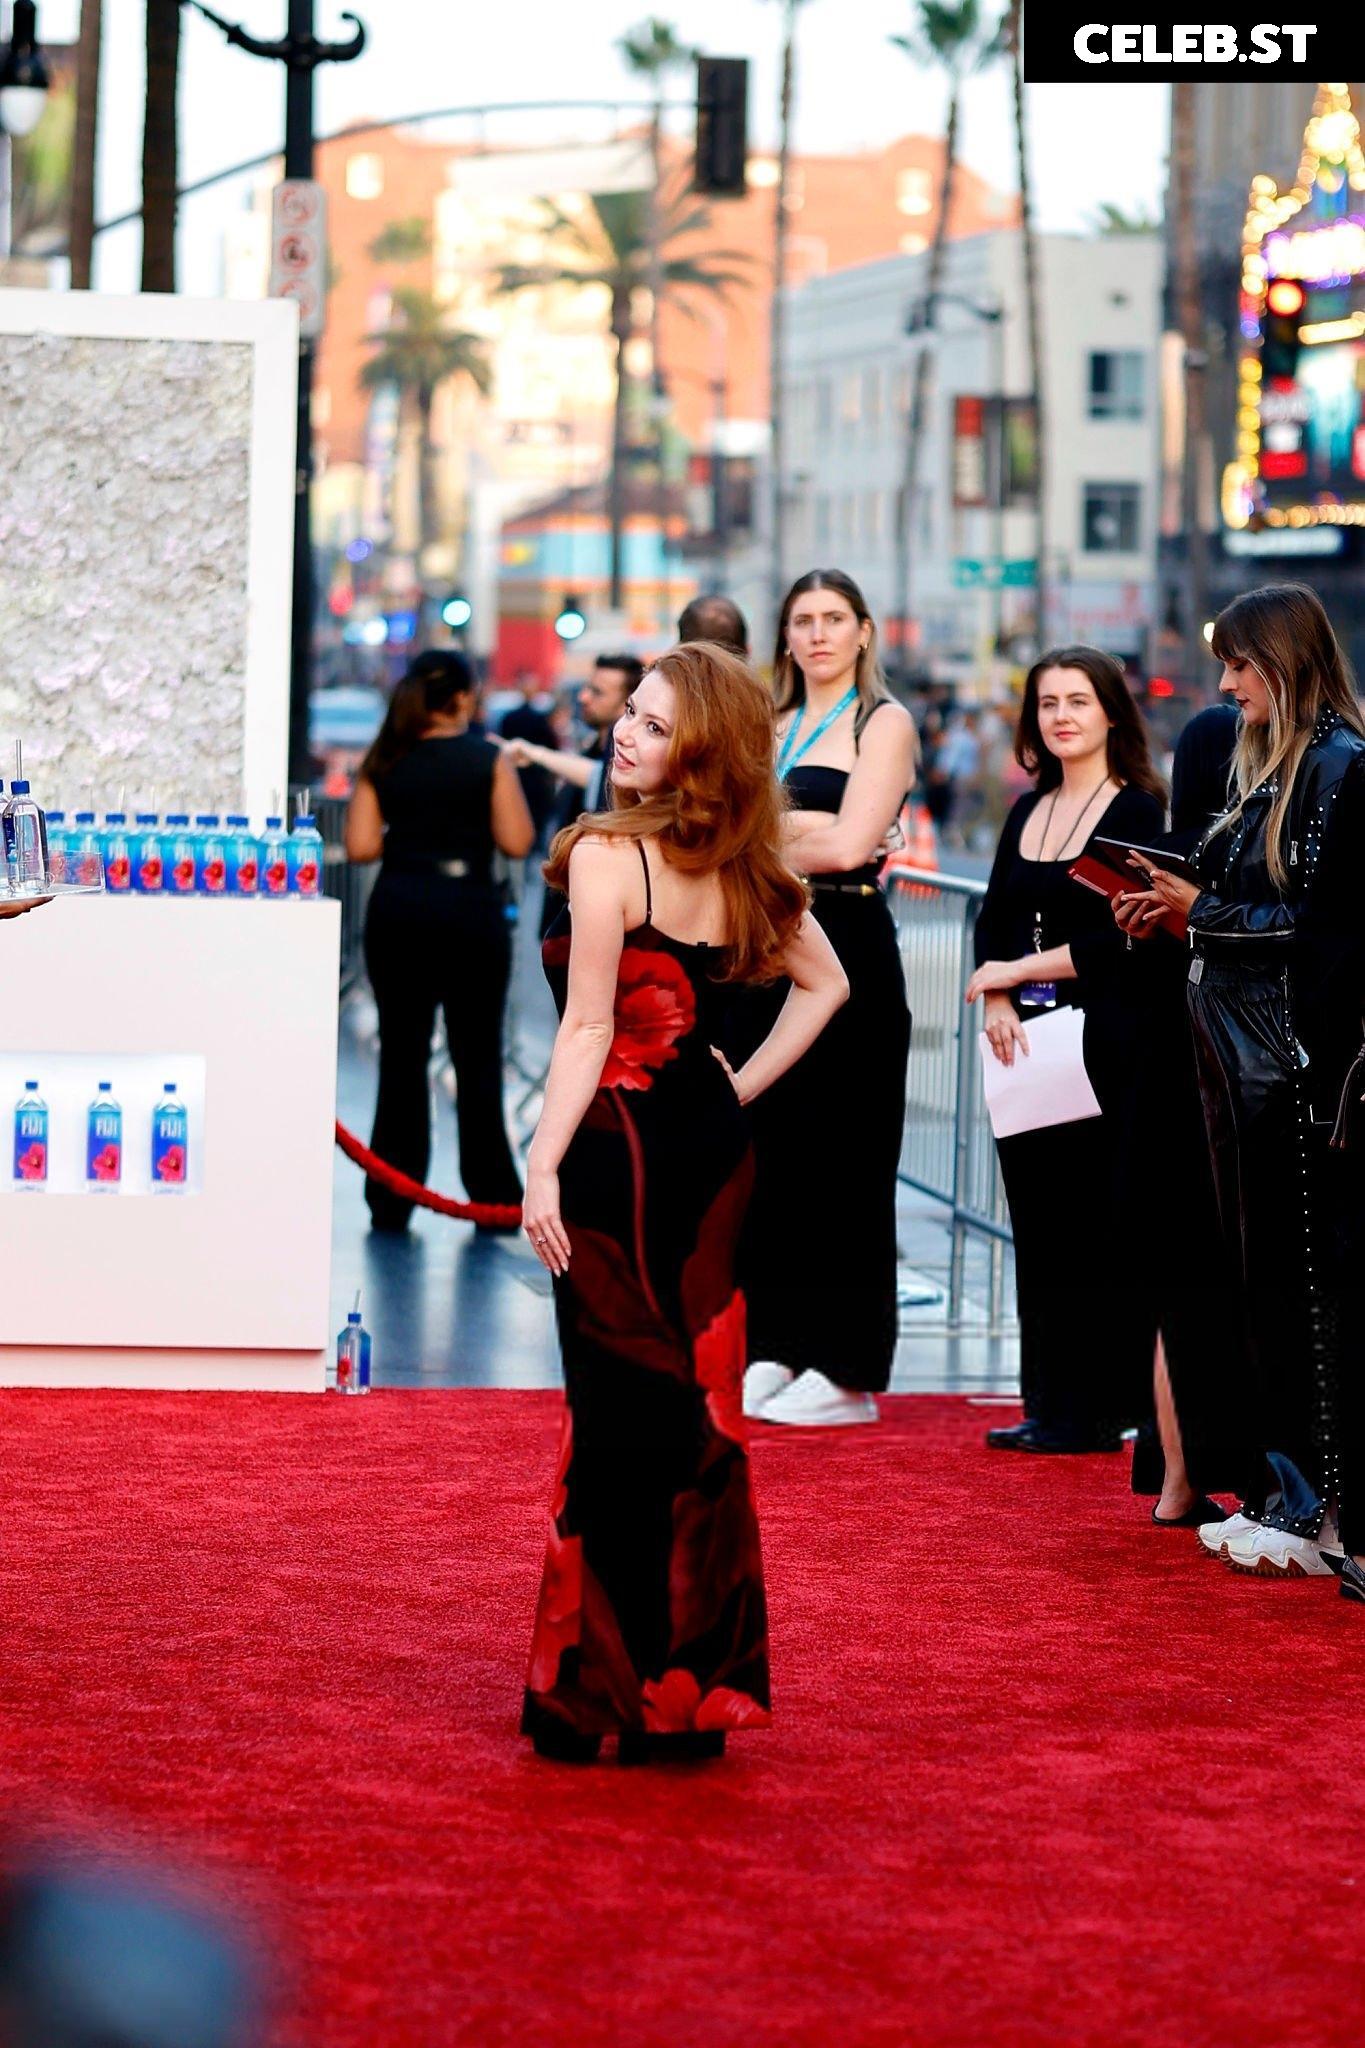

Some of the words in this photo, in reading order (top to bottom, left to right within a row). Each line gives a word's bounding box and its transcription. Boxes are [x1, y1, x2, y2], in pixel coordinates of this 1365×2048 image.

[22, 1117, 43, 1137] FIJI
[96, 1117, 118, 1138] FIJI
[161, 1118, 182, 1138] FIJI
